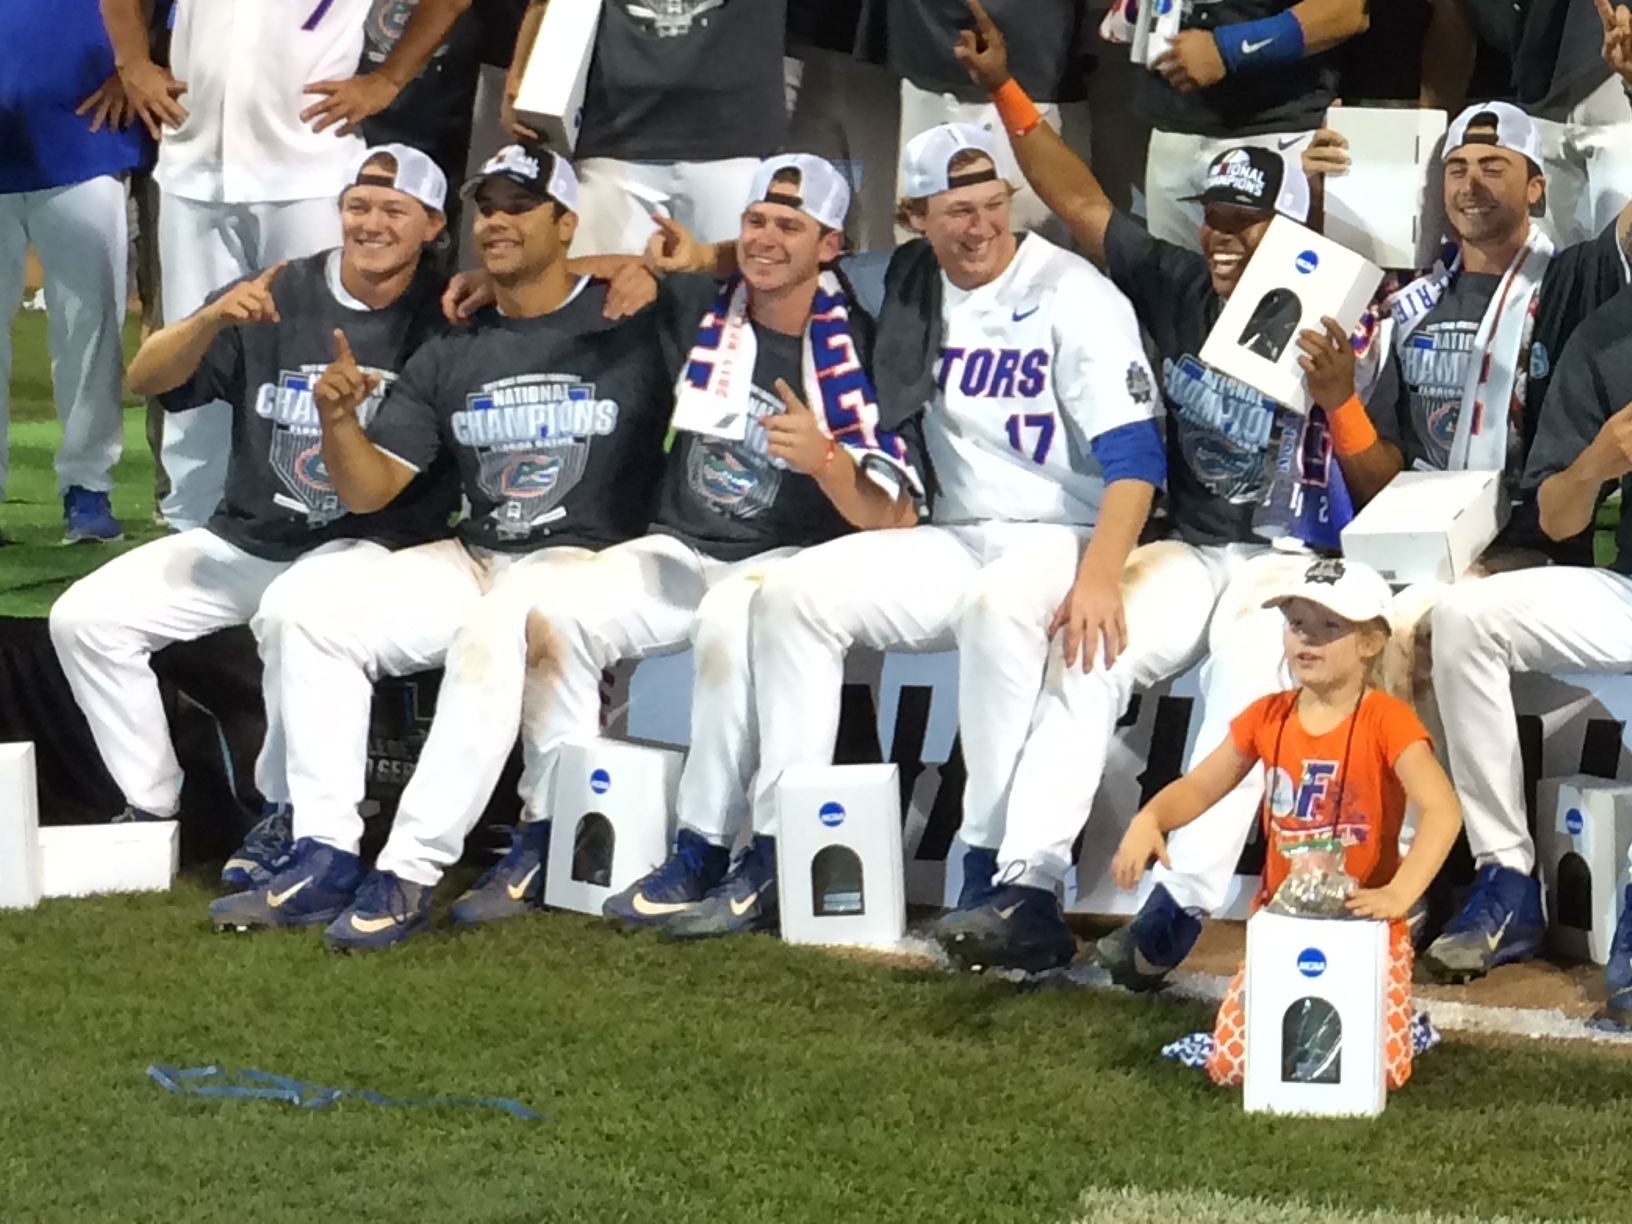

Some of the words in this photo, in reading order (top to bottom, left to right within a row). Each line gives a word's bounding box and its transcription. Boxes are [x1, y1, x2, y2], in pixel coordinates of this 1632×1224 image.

[493, 383, 570, 407] NATIONAL
[938, 347, 1050, 398] TORS
[451, 398, 619, 446] CHAMPIONS
[1005, 411, 1056, 466] 17
[1294, 758, 1340, 821] F
